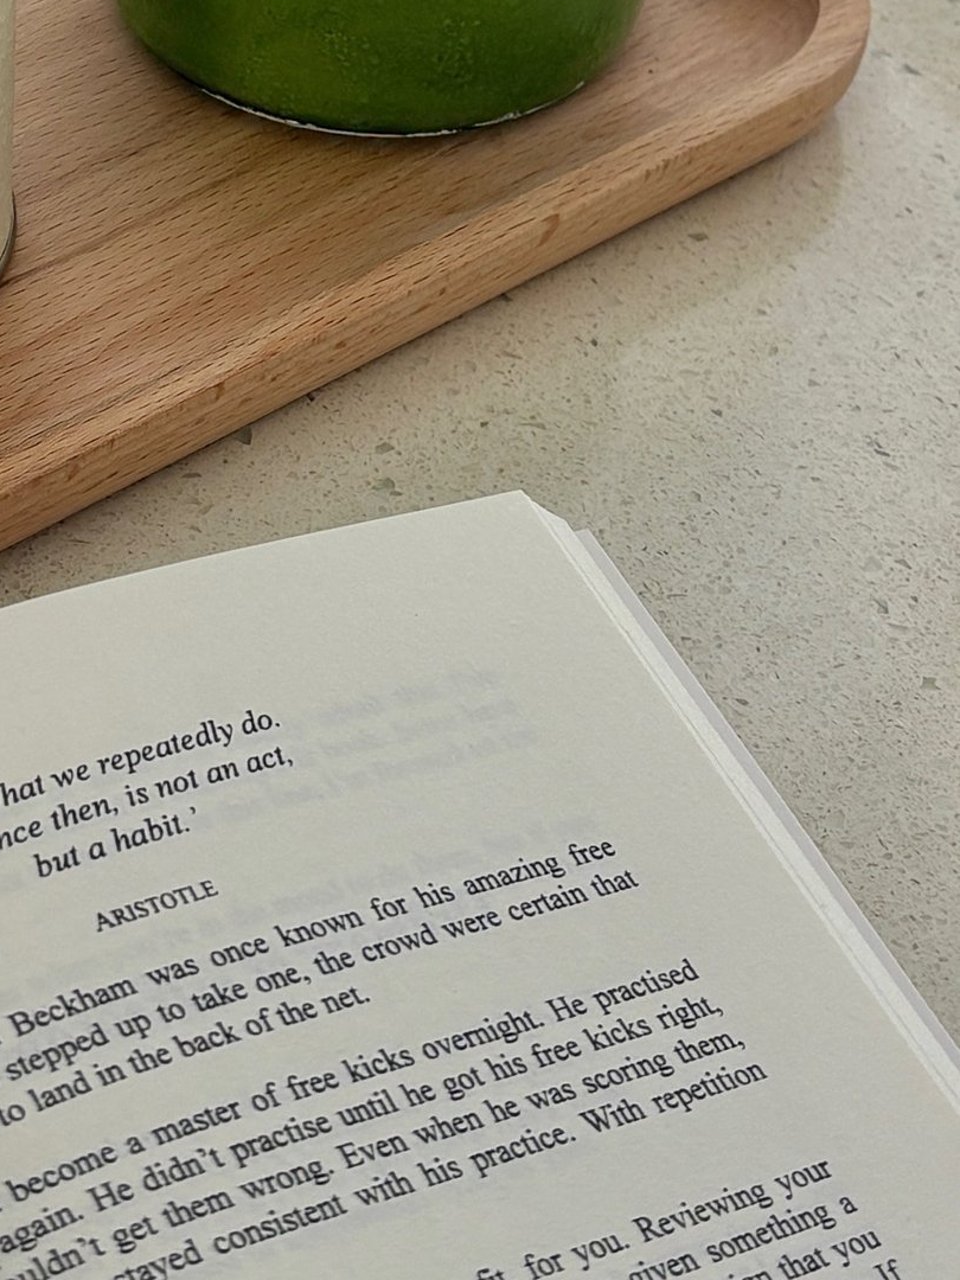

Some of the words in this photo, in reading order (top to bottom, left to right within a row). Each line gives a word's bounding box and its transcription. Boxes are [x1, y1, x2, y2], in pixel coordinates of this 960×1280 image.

[49, 763, 92, 789] we
[96, 719, 234, 776] repeatedly
[241, 709, 281, 736] do.
[49, 798, 119, 832] then,
[123, 784, 150, 808] is
[153, 769, 200, 799] not
[206, 761, 240, 785] an
[246, 746, 294, 774] act,
[32, 845, 82, 878] but
[88, 841, 108, 861] a
[96, 879, 219, 933] ARISTOTLE
[4, 1021, 111, 1082] stepped
[112, 1014, 152, 1041] up
[155, 1002, 187, 1024] to
[189, 982, 249, 1013] take
[254, 967, 313, 994] one,
[312, 950, 356, 976] the
[361, 921, 439, 963] crowd
[440, 910, 503, 939] were
[507, 883, 590, 921] certain
[589, 869, 640, 898] that
[5, 979, 140, 1038] Beckham
[144, 958, 201, 986] was
[209, 937, 271, 968] once
[272, 910, 366, 948] known
[369, 896, 410, 922] for
[411, 882, 456, 909] his
[462, 856, 567, 896] amazing
[567, 841, 617, 868] free
[3, 1146, 119, 1203] become
[124, 1136, 147, 1156] a
[149, 1101, 243, 1147] master
[250, 1081, 283, 1113] of
[285, 1072, 341, 1102] free
[340, 1048, 416, 1084] kicks
[421, 1010, 546, 1060] overnight.
[544, 995, 589, 1023] He
[591, 957, 701, 1017] practised
[26, 1069, 93, 1113] land
[91, 1063, 128, 1087] in
[125, 1047, 174, 1074] the
[170, 1021, 243, 1058] back
[244, 1006, 275, 1037] of
[274, 1000, 319, 1027] the
[319, 986, 371, 1015] net.
[84, 1180, 135, 1213] He
[227, 1115, 334, 1170] practise
[334, 1088, 401, 1127] until
[397, 1083, 437, 1108] he
[442, 1066, 487, 1102] got
[482, 1052, 529, 1082] his
[530, 1040, 583, 1069] free
[581, 1017, 654, 1052] kicks
[655, 996, 724, 1031] right,
[111, 1216, 160, 1255] get
[160, 1191, 237, 1228] them
[236, 1160, 336, 1200] wrong.
[333, 1135, 411, 1170] Even
[410, 1112, 486, 1145] when
[481, 1099, 522, 1124] he
[523, 1082, 578, 1110] was
[581, 1054, 676, 1095] scoring
[672, 1033, 746, 1065] them,
[212, 1194, 349, 1255] consistent
[352, 1170, 417, 1206] with
[415, 1156, 464, 1188] his
[467, 1127, 577, 1179] practice.
[577, 1097, 648, 1133] With
[650, 1063, 769, 1114] repetition
[523, 1253, 566, 1280] for
[569, 1234, 631, 1272] you.
[630, 1183, 775, 1244] Reviewing
[773, 1160, 833, 1201] your
[705, 1204, 838, 1264] something
[838, 1196, 859, 1215] a
[778, 1254, 831, 1280] that
[830, 1230, 882, 1268] you
